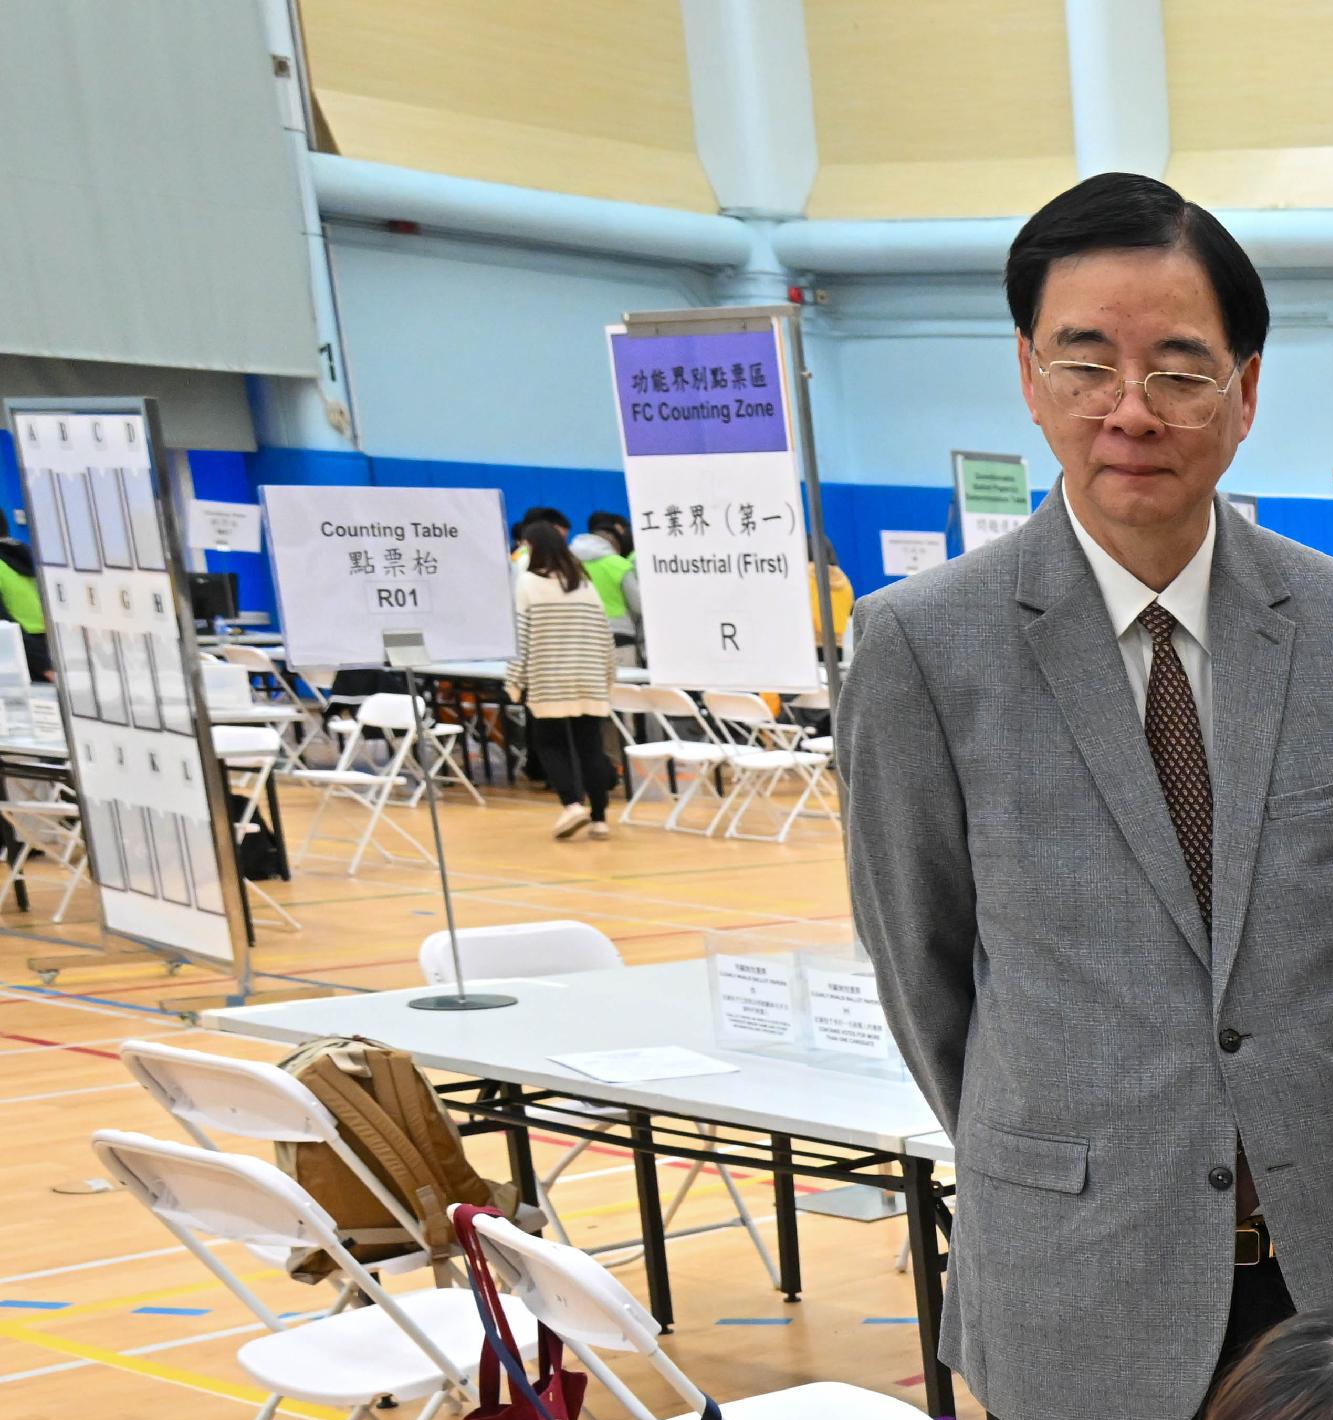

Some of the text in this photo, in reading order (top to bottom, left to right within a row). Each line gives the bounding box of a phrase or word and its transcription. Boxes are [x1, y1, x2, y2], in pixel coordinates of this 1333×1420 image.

[631, 363, 767, 394] 功能界別點票區
[632, 399, 774, 424] FC Counting Zone
[320, 522, 459, 541] Counting Table
[348, 548, 439, 578] 點票枱
[653, 554, 789, 578] Industrial (First)
[377, 588, 419, 608] R01
[720, 622, 740, 651] R
